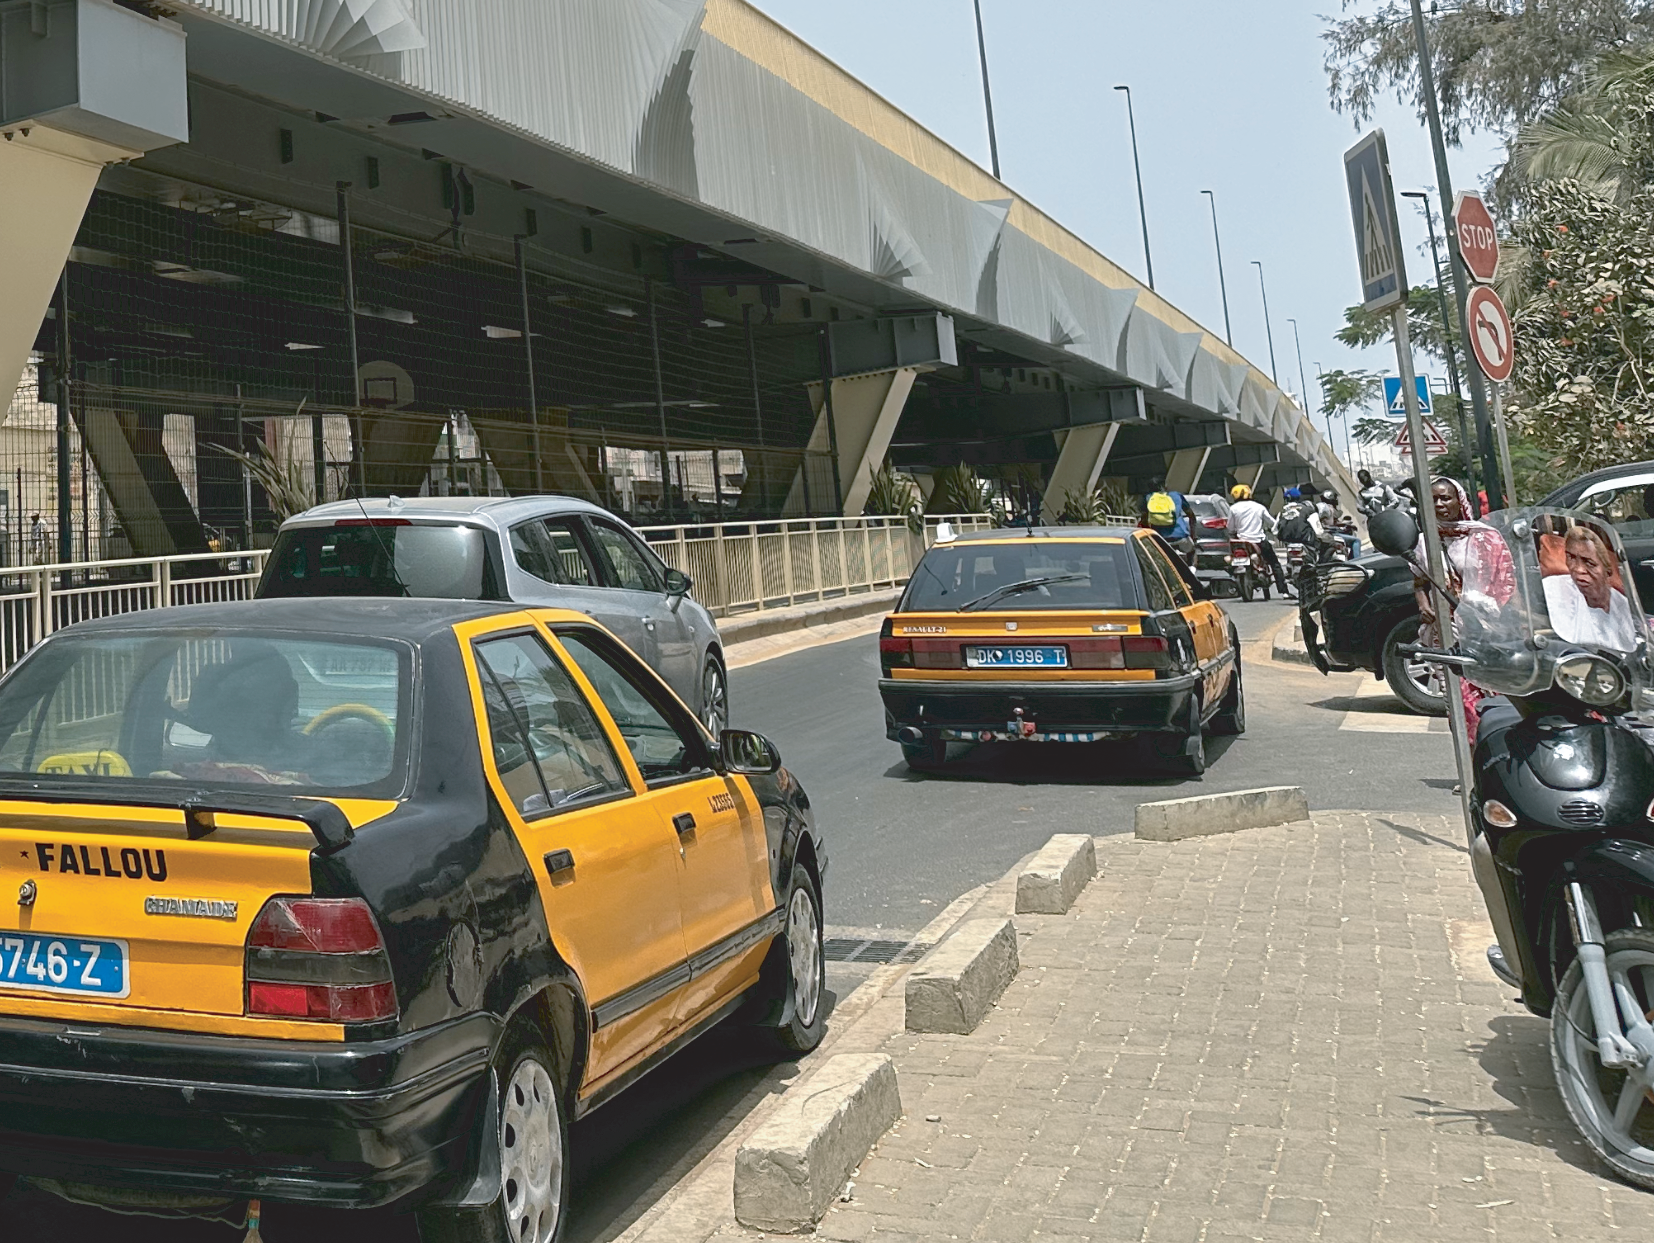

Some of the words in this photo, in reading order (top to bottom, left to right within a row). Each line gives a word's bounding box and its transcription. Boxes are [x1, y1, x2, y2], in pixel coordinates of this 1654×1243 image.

[1461, 223, 1494, 251] STOP
[978, 649, 997, 664] DK
[1008, 649, 1044, 664] 1996
[1053, 649, 1063, 664] T
[35, 842, 167, 882] FALLOU
